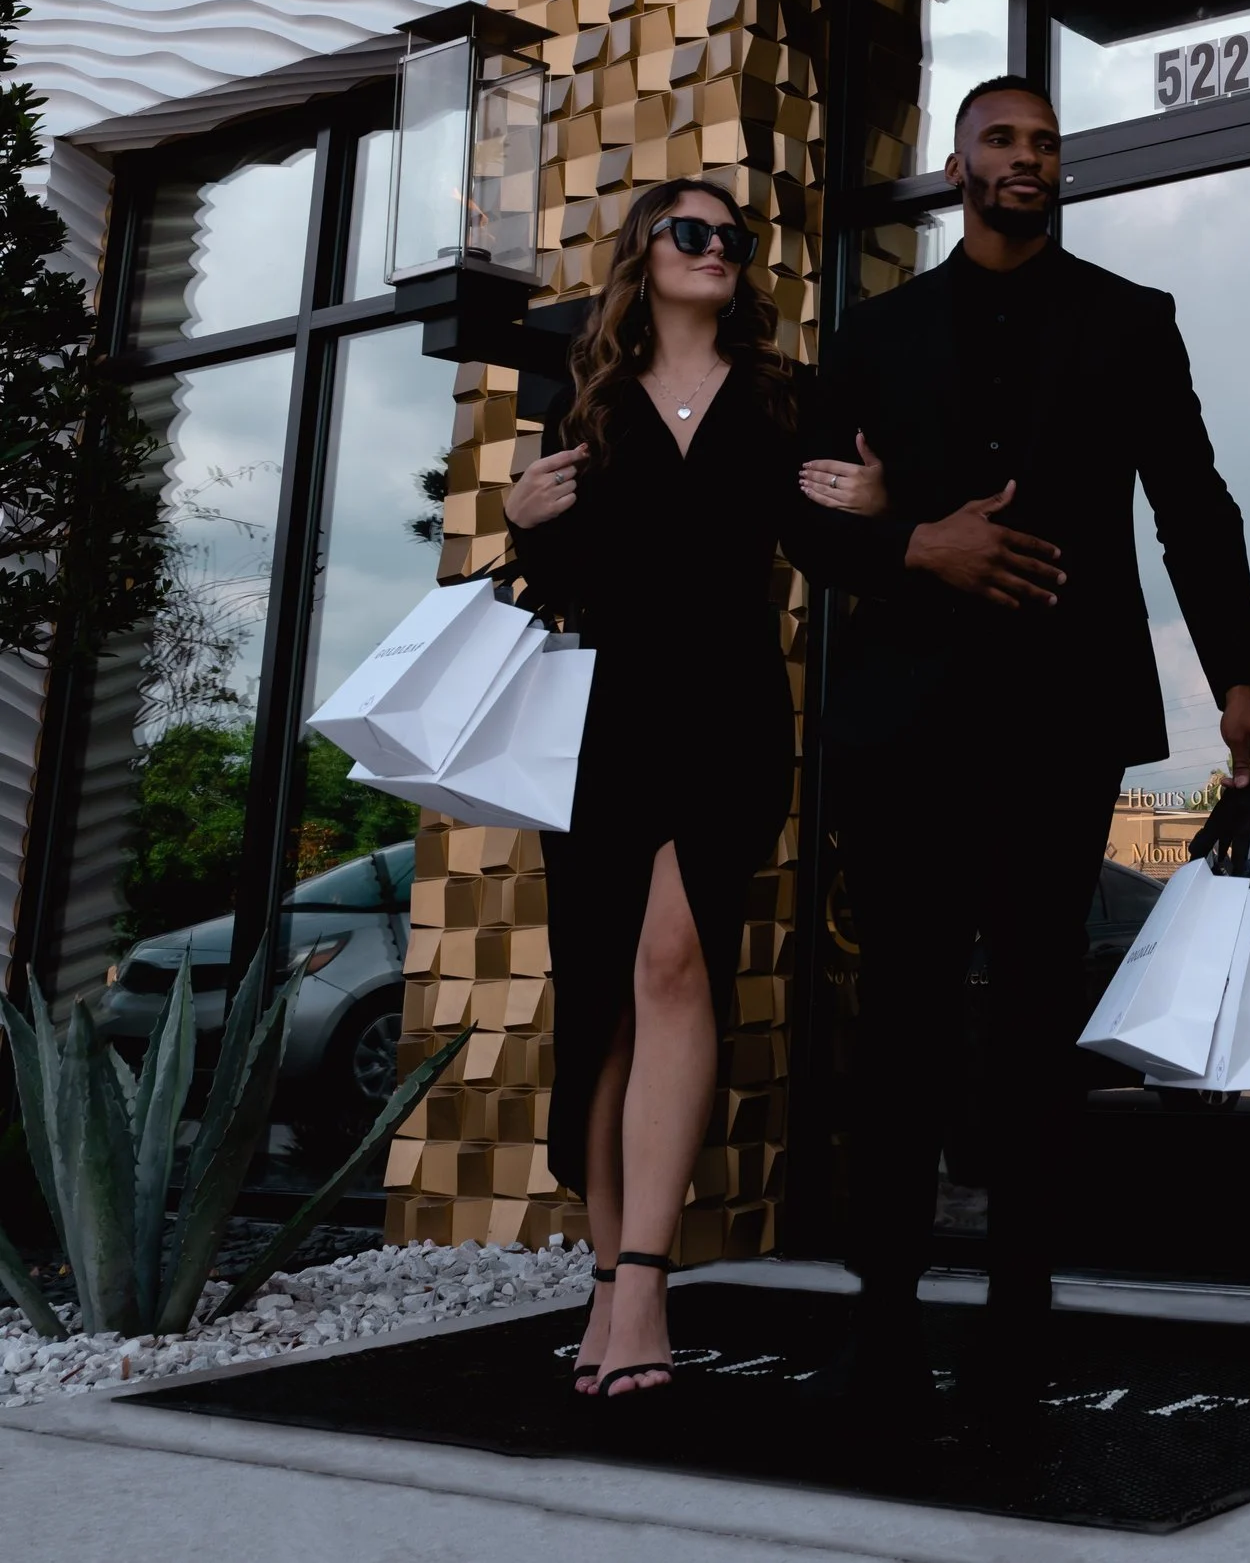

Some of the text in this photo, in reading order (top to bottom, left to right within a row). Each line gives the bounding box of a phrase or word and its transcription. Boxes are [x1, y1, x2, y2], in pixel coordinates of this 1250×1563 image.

[1127, 787, 1186, 808] Hours
[1190, 783, 1214, 806] of
[1131, 840, 1191, 865] Mond
